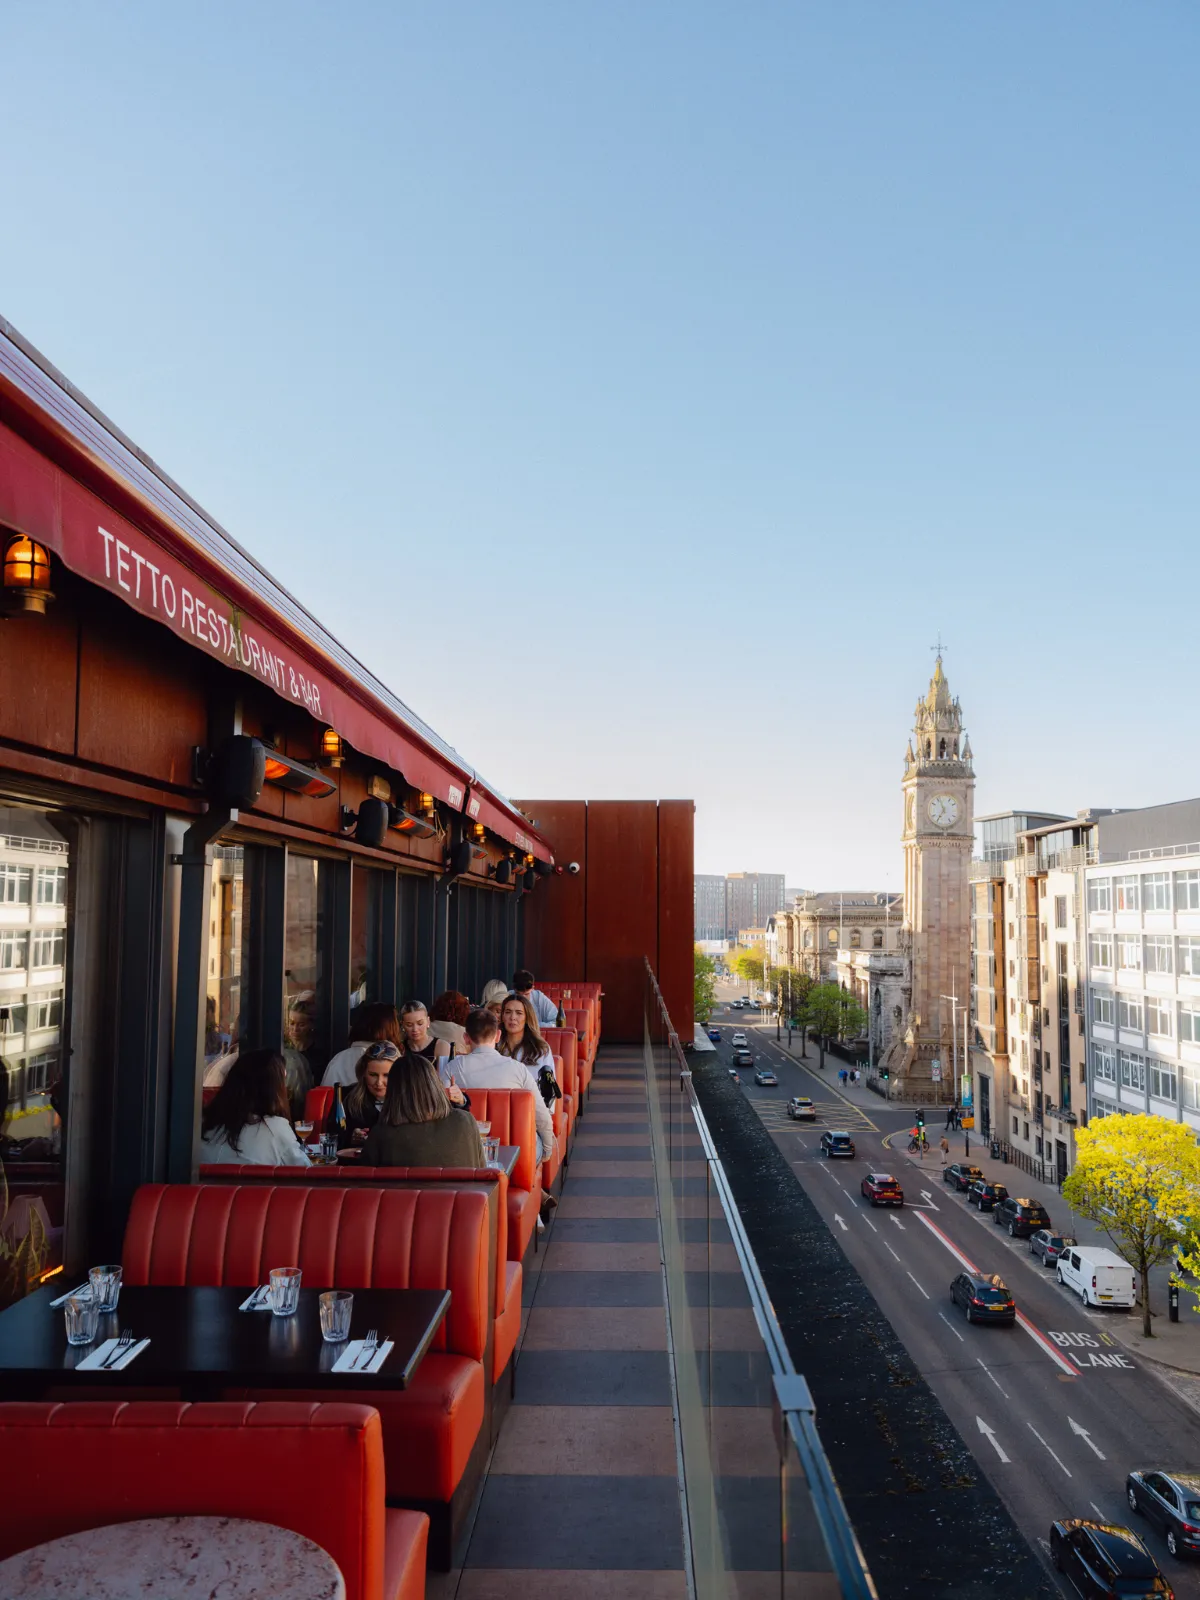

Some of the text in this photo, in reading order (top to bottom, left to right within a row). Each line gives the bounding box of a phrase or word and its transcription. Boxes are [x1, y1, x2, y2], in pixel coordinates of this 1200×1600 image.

[98, 526, 322, 716] TETTO RESTAURANT & BAR
[1048, 1331, 1100, 1348] BUS
[1068, 1352, 1136, 1369] LANE
